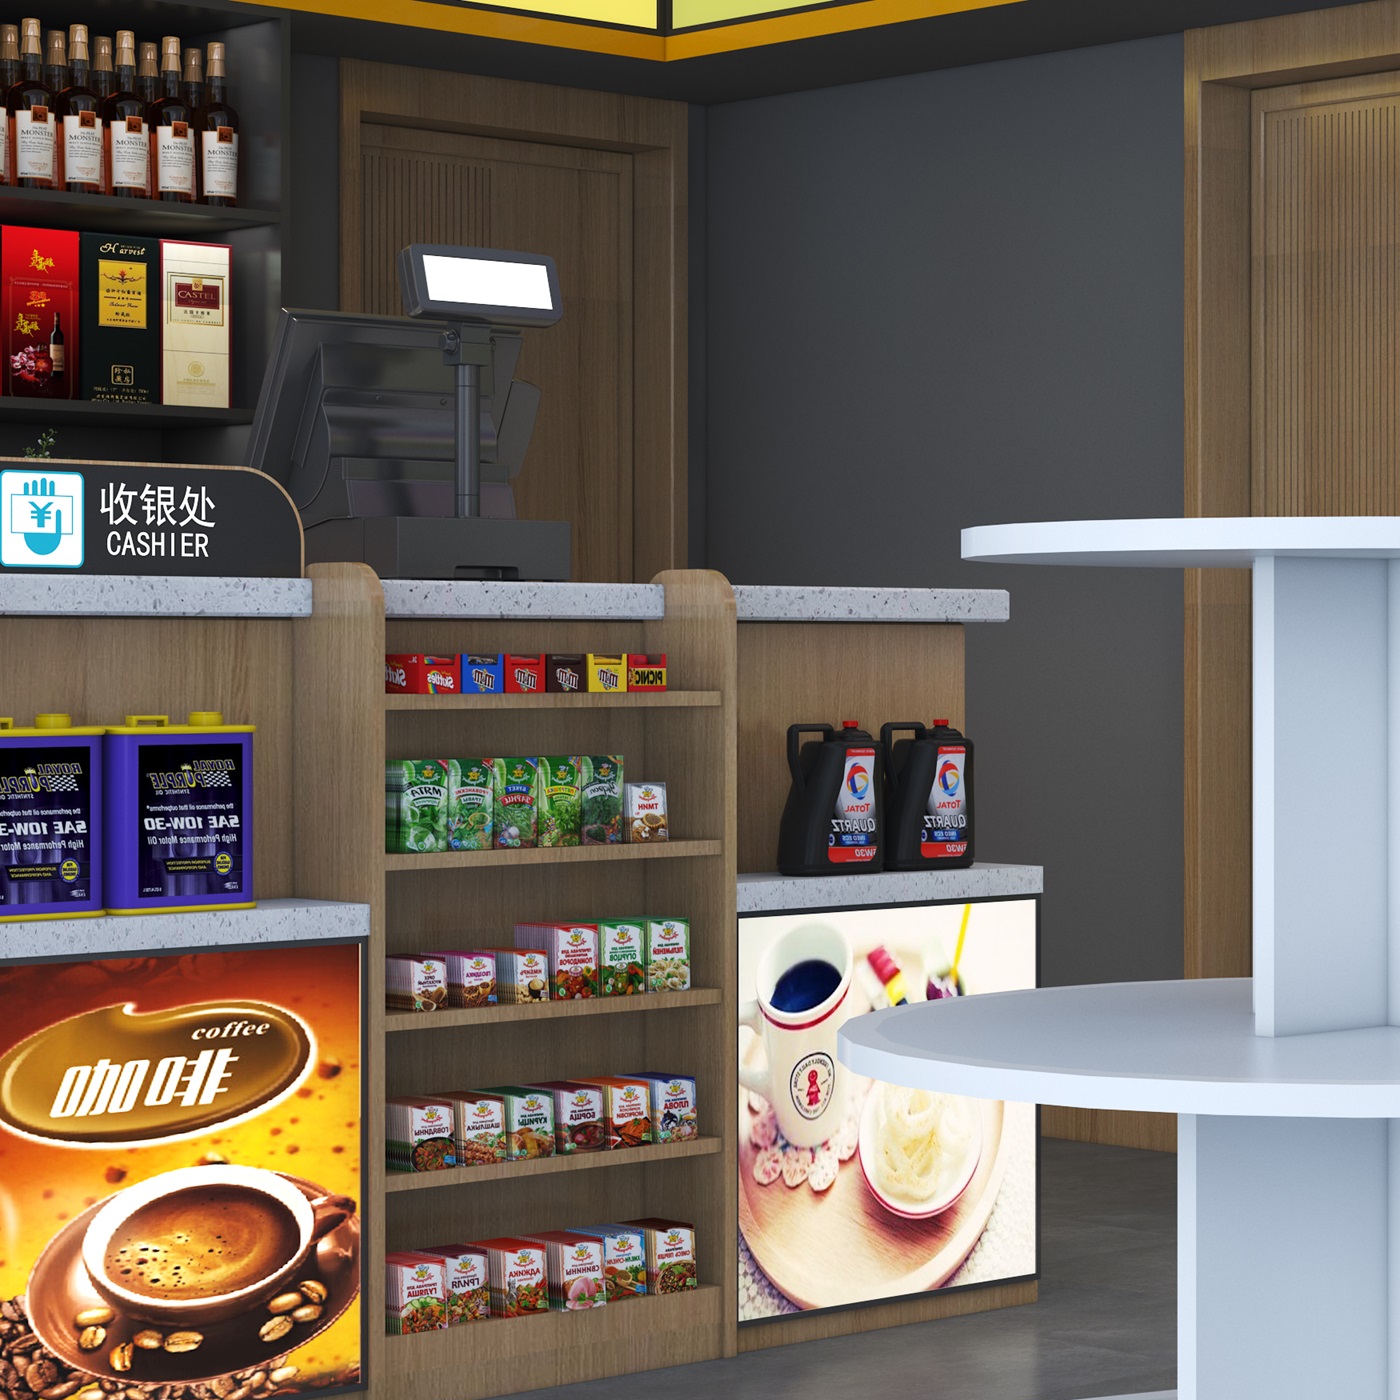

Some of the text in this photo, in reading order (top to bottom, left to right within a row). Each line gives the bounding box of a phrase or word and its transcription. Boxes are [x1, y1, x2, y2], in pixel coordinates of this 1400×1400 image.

[177, 290, 217, 300] CASTEL
[100, 482, 216, 528] 收银处
[106, 530, 209, 557] CASHIER
[190, 1019, 270, 1041] coffee
[50, 1048, 239, 1118] 咖啡
